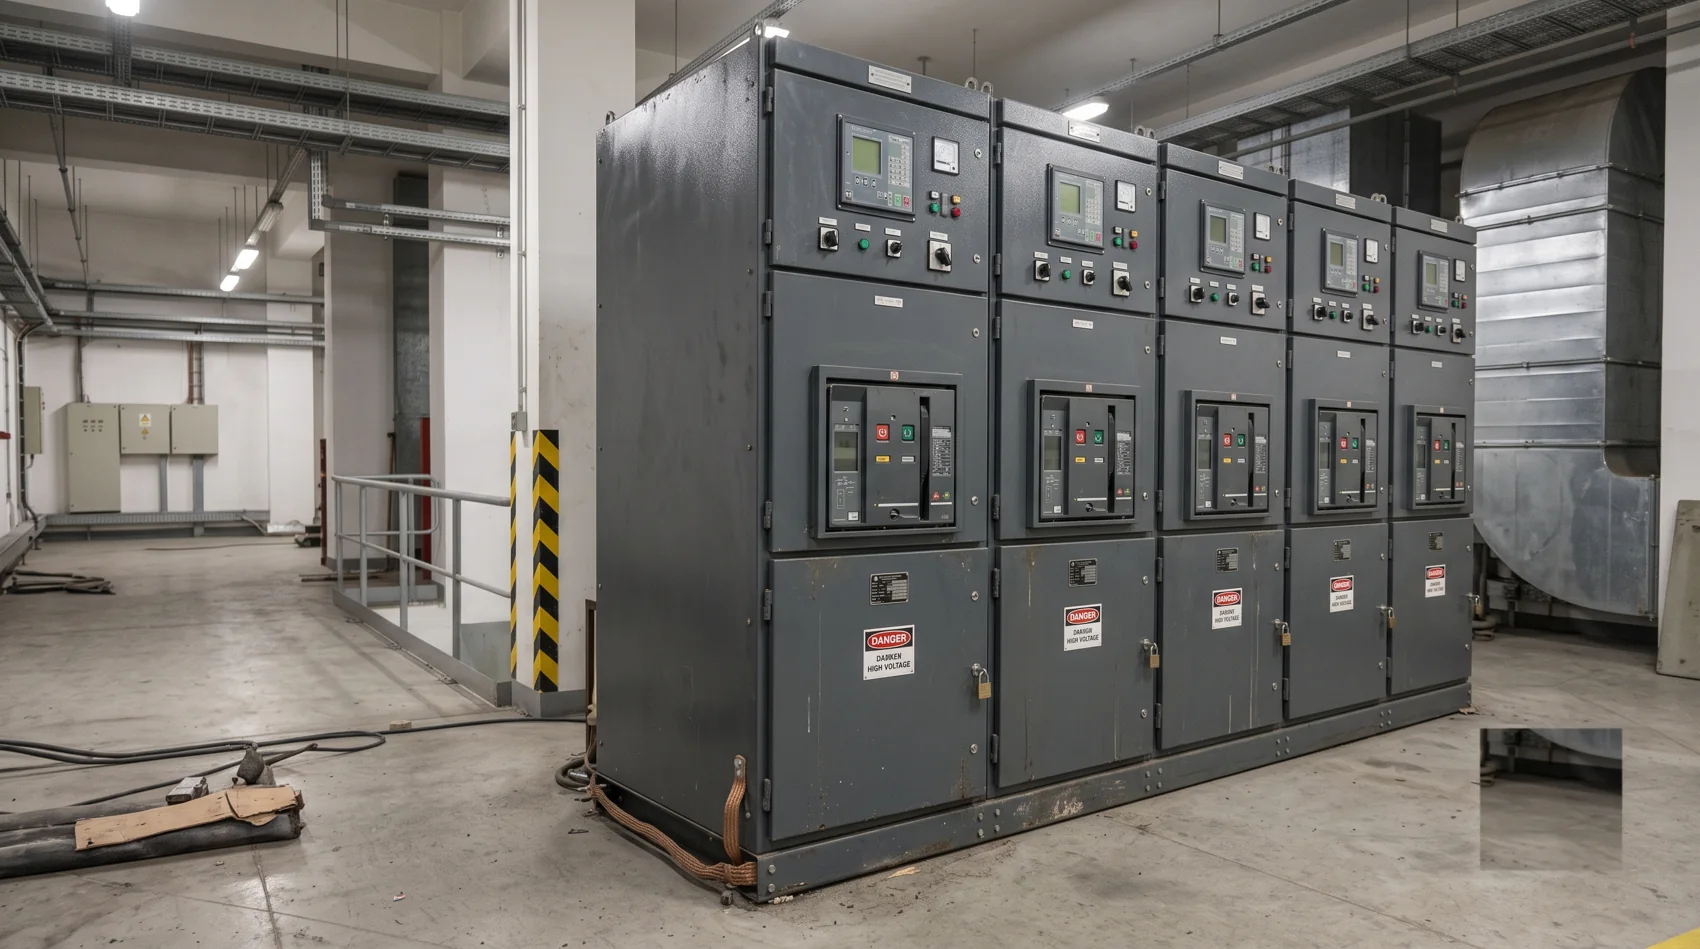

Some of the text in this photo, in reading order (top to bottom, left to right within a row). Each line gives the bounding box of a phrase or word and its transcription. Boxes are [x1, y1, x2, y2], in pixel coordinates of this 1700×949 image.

[1070, 611, 1096, 622] DANGER
[871, 634, 907, 646] DANGER
[884, 660, 911, 670] VOLTAGE
